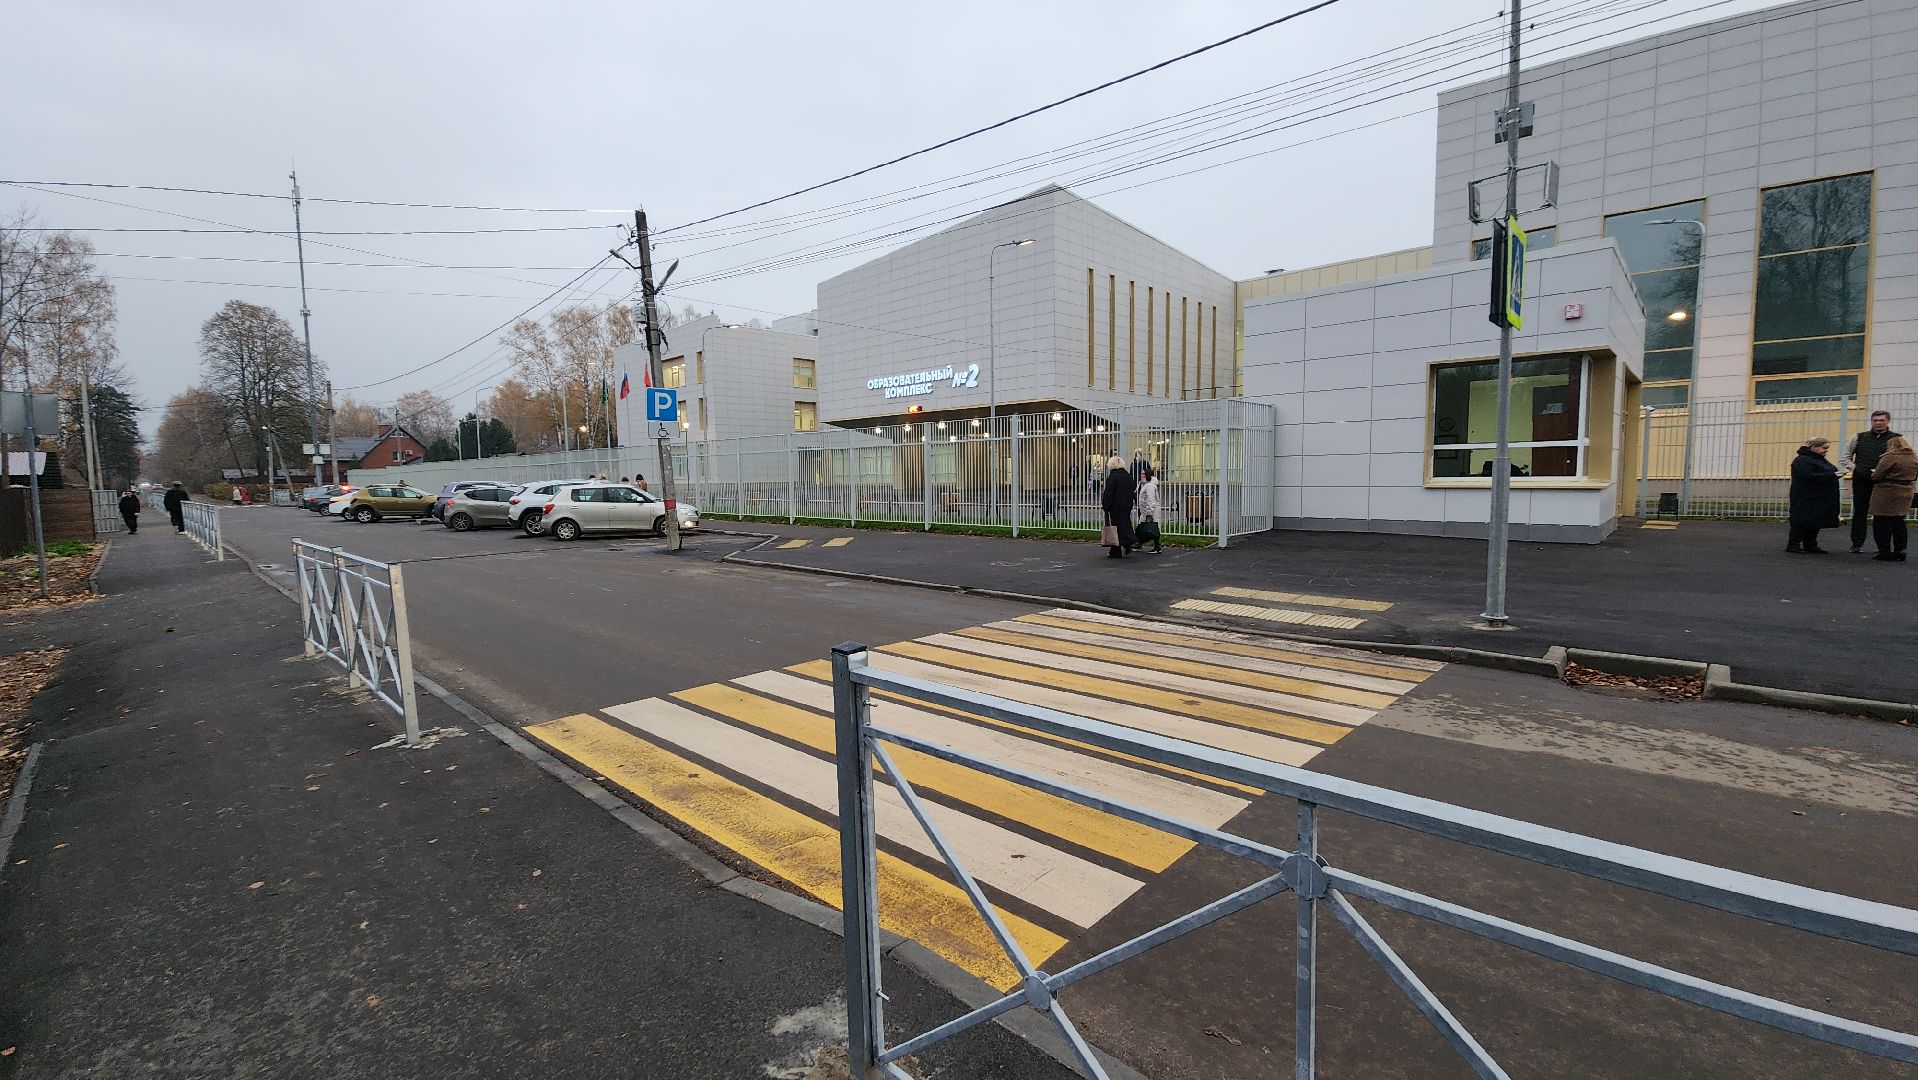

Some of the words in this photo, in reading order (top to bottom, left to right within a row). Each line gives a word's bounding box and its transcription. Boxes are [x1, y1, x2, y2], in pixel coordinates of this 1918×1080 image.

[867, 364, 953, 390] ОБРАЗОВАТЕЛЬНЫЙ
[952, 364, 979, 388] №2
[885, 383, 933, 398] КОМПЛЕКС
[655, 392, 672, 417] P
